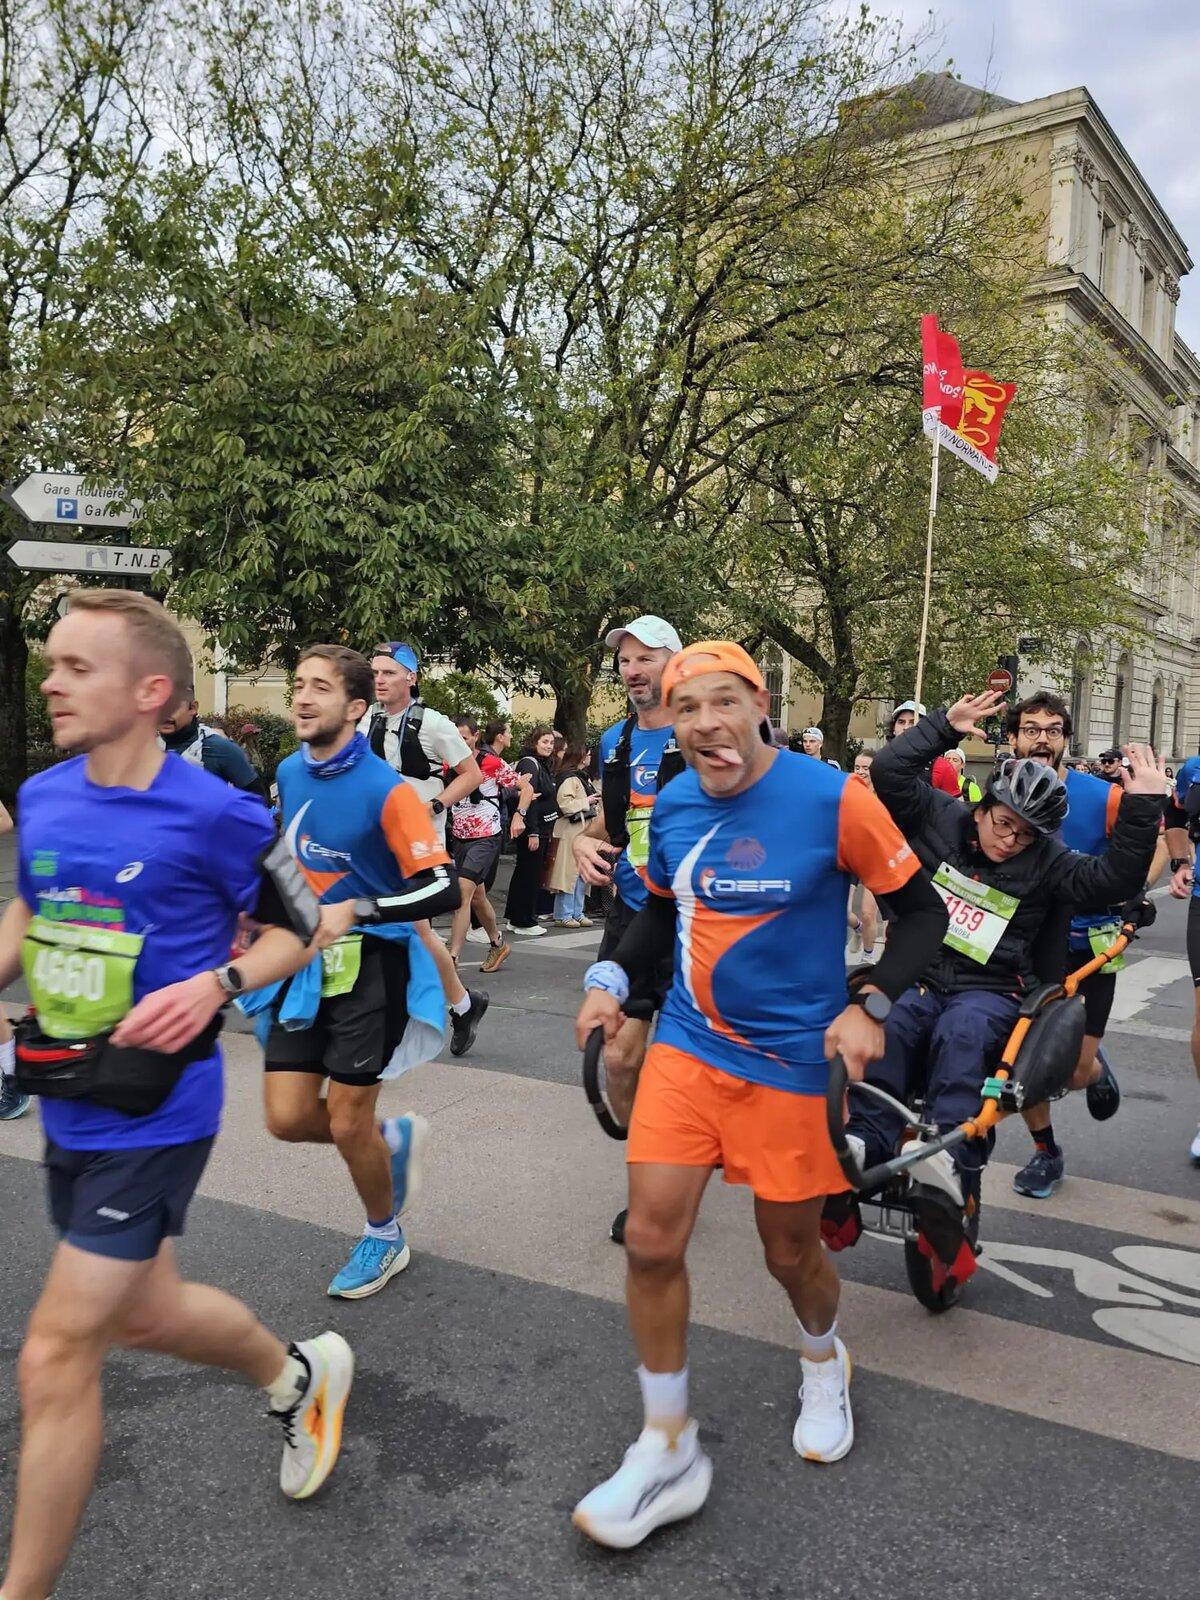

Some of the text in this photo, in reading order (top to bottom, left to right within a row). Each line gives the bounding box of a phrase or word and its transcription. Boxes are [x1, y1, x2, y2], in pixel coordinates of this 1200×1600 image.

[43, 482, 70, 495] Gare
[945, 895, 985, 932] 1159
[379, 1246, 397, 1273] HOKA
